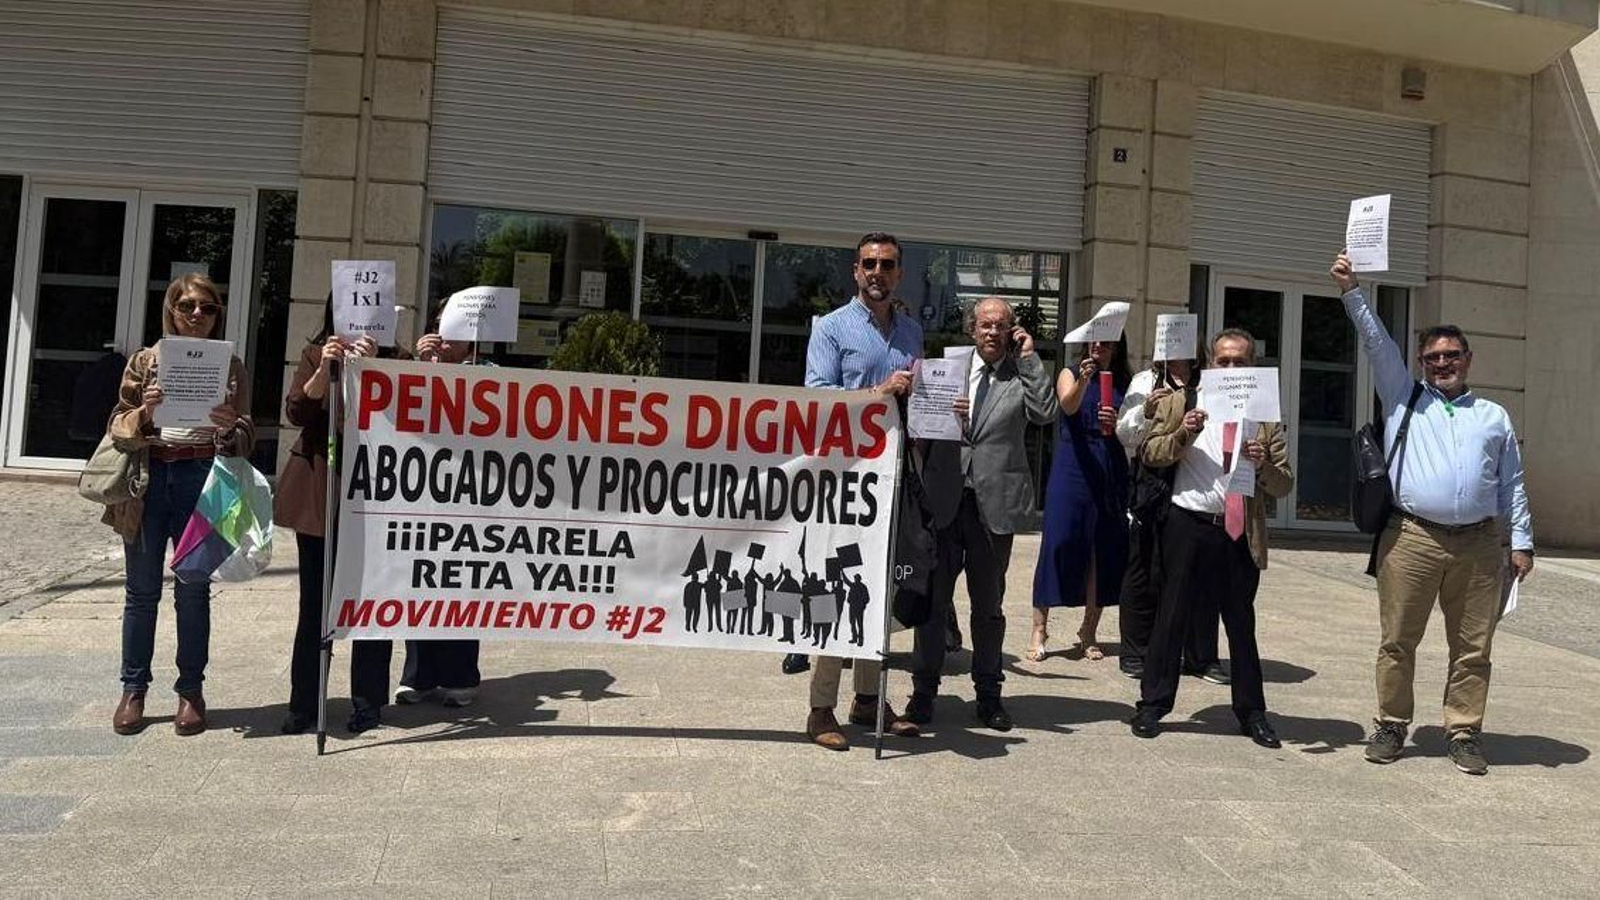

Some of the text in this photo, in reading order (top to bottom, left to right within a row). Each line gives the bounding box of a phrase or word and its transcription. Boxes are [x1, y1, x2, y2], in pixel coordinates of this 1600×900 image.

[355, 271, 379, 284] #J2
[352, 291, 380, 306] 1x1
[349, 322, 385, 331] Pasarela
[186, 350, 204, 358] #J2
[358, 370, 670, 447] PENSIONES
[686, 395, 888, 460] DIGNAS
[347, 445, 879, 527] ABOGADOS Y PROCURADORES
[411, 560, 616, 594] RETA YA!!!
[337, 599, 666, 640] MOVIMIENTO #J2
